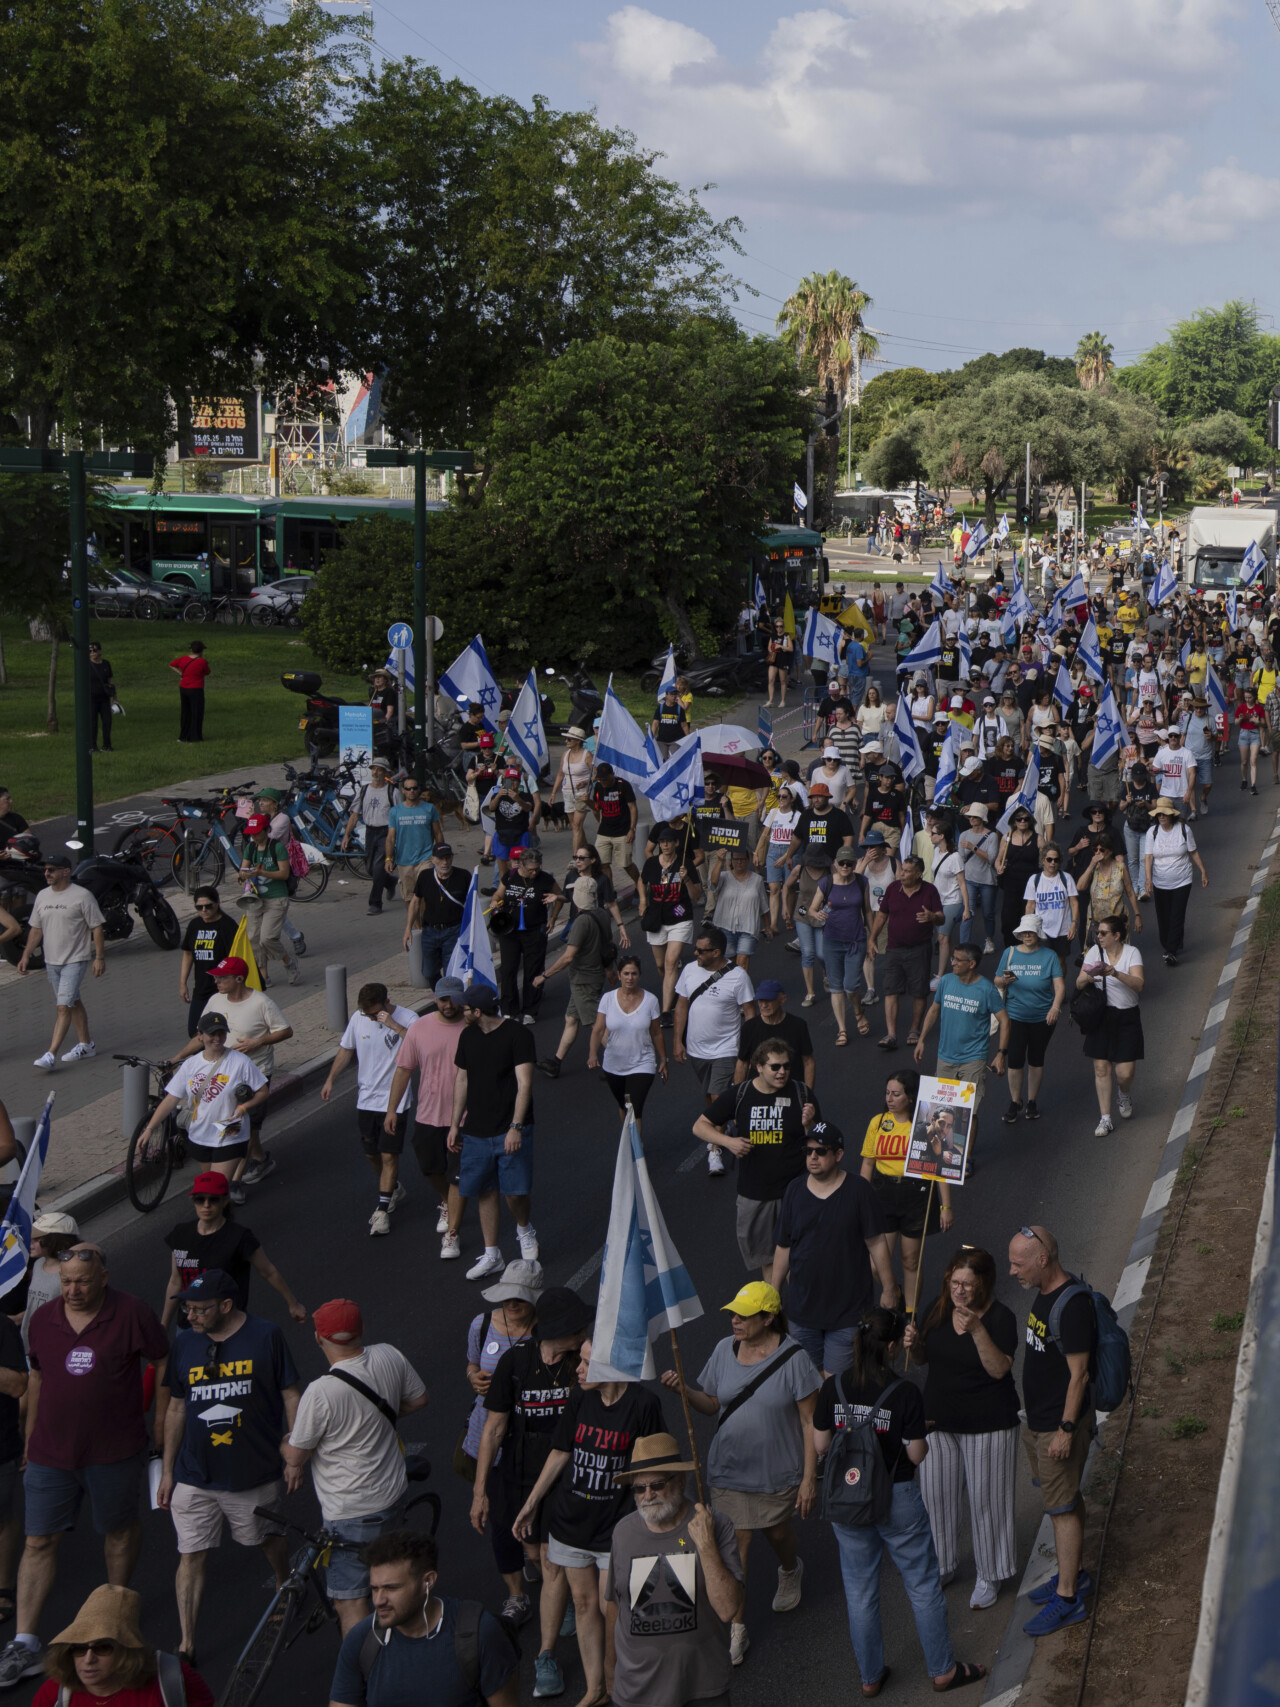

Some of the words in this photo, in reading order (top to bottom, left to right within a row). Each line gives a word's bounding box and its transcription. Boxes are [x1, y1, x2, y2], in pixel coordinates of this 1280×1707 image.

[711, 826, 740, 838] עסקה
[708, 834, 741, 847] עכשיו!
[943, 993, 964, 1004] #BRING
[963, 998, 980, 1007] THEM
[943, 1000, 961, 1011] HOME
[960, 1004, 979, 1014] NOW!
[750, 1105, 769, 1120] GET
[769, 1105, 784, 1120] MY
[749, 1118, 784, 1132] PEOPLE
[749, 1131, 784, 1145] HOME!
[189, 1359, 254, 1385] מאק
[190, 1379, 253, 1402] האקדמיה
[574, 1422, 631, 1451] עוצרים
[610, 1455, 627, 1470] עד
[632, 1614, 694, 1633] Reebok
